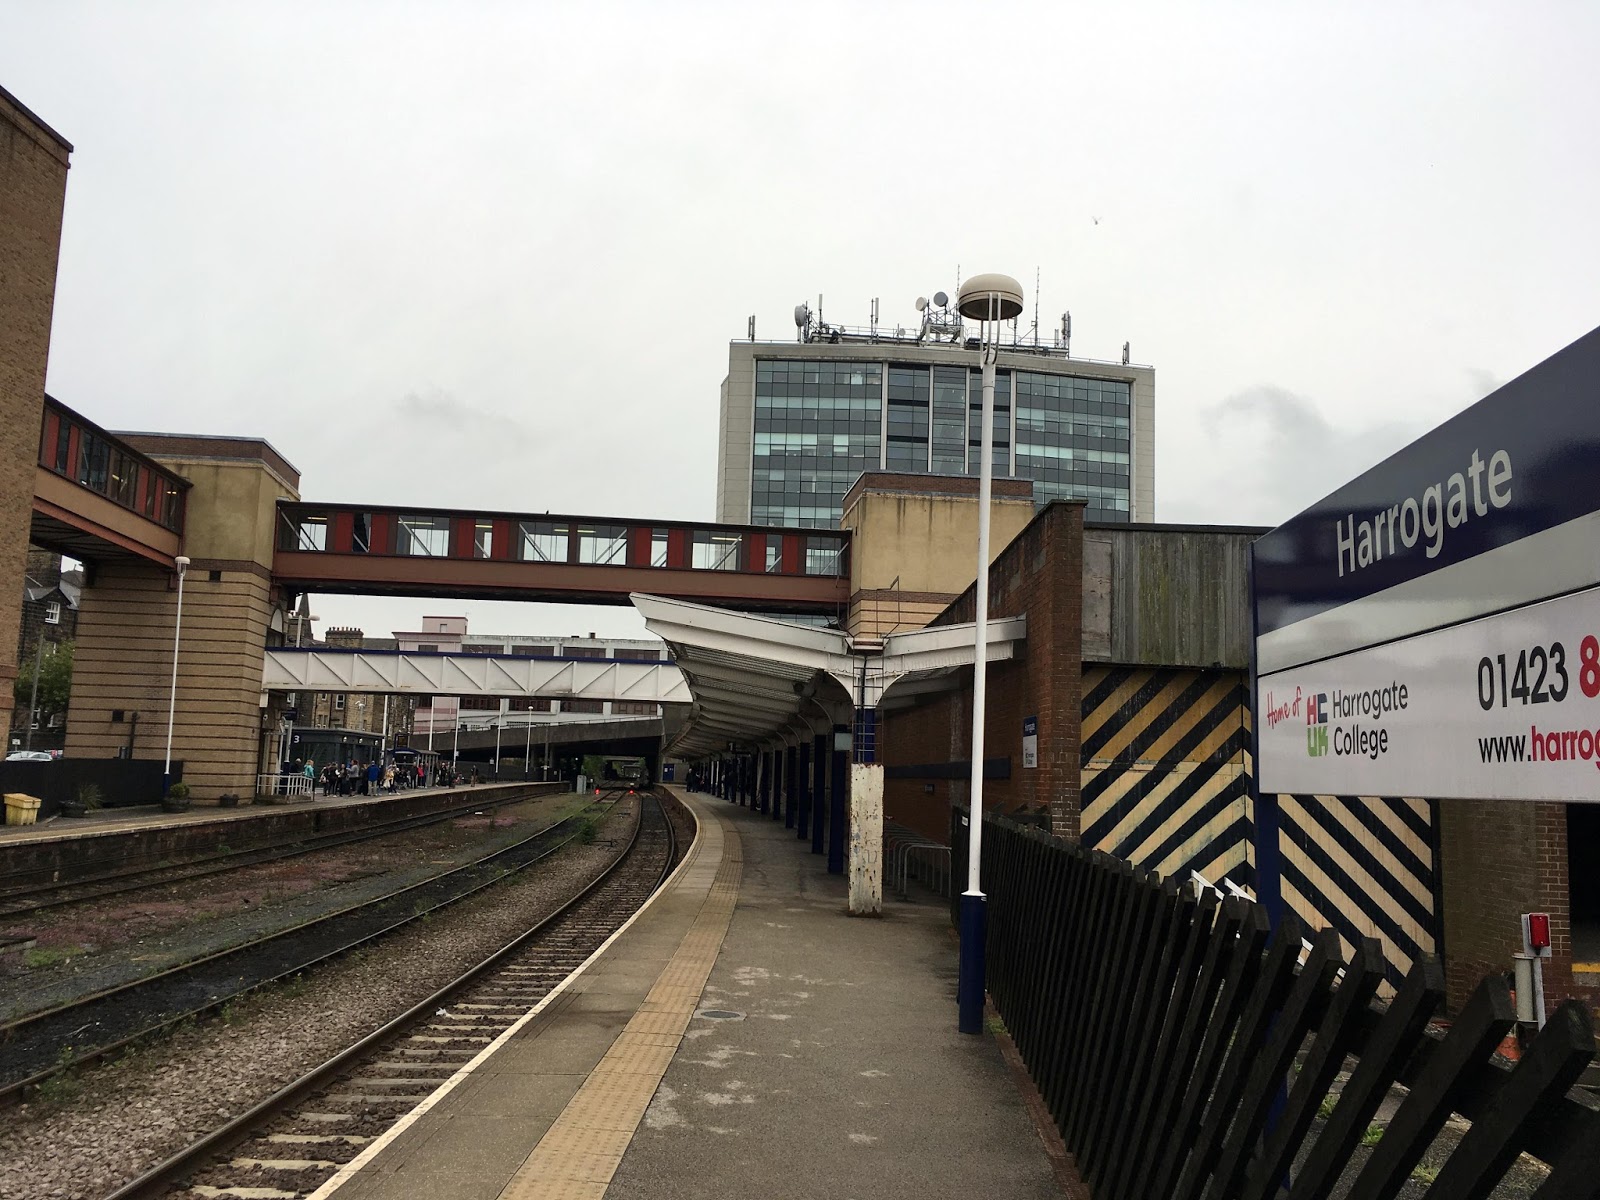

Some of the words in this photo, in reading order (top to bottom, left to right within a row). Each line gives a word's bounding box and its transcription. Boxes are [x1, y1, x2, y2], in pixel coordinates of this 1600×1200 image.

[1336, 448, 1514, 578] Harrogate
[1477, 641, 1569, 711] 01423
[1266, 691, 1291, 729] Home
[1292, 686, 1302, 717] of
[1332, 680, 1409, 720] Harrogate
[293, 735, 301, 744] 3
[1333, 724, 1388, 760] College
